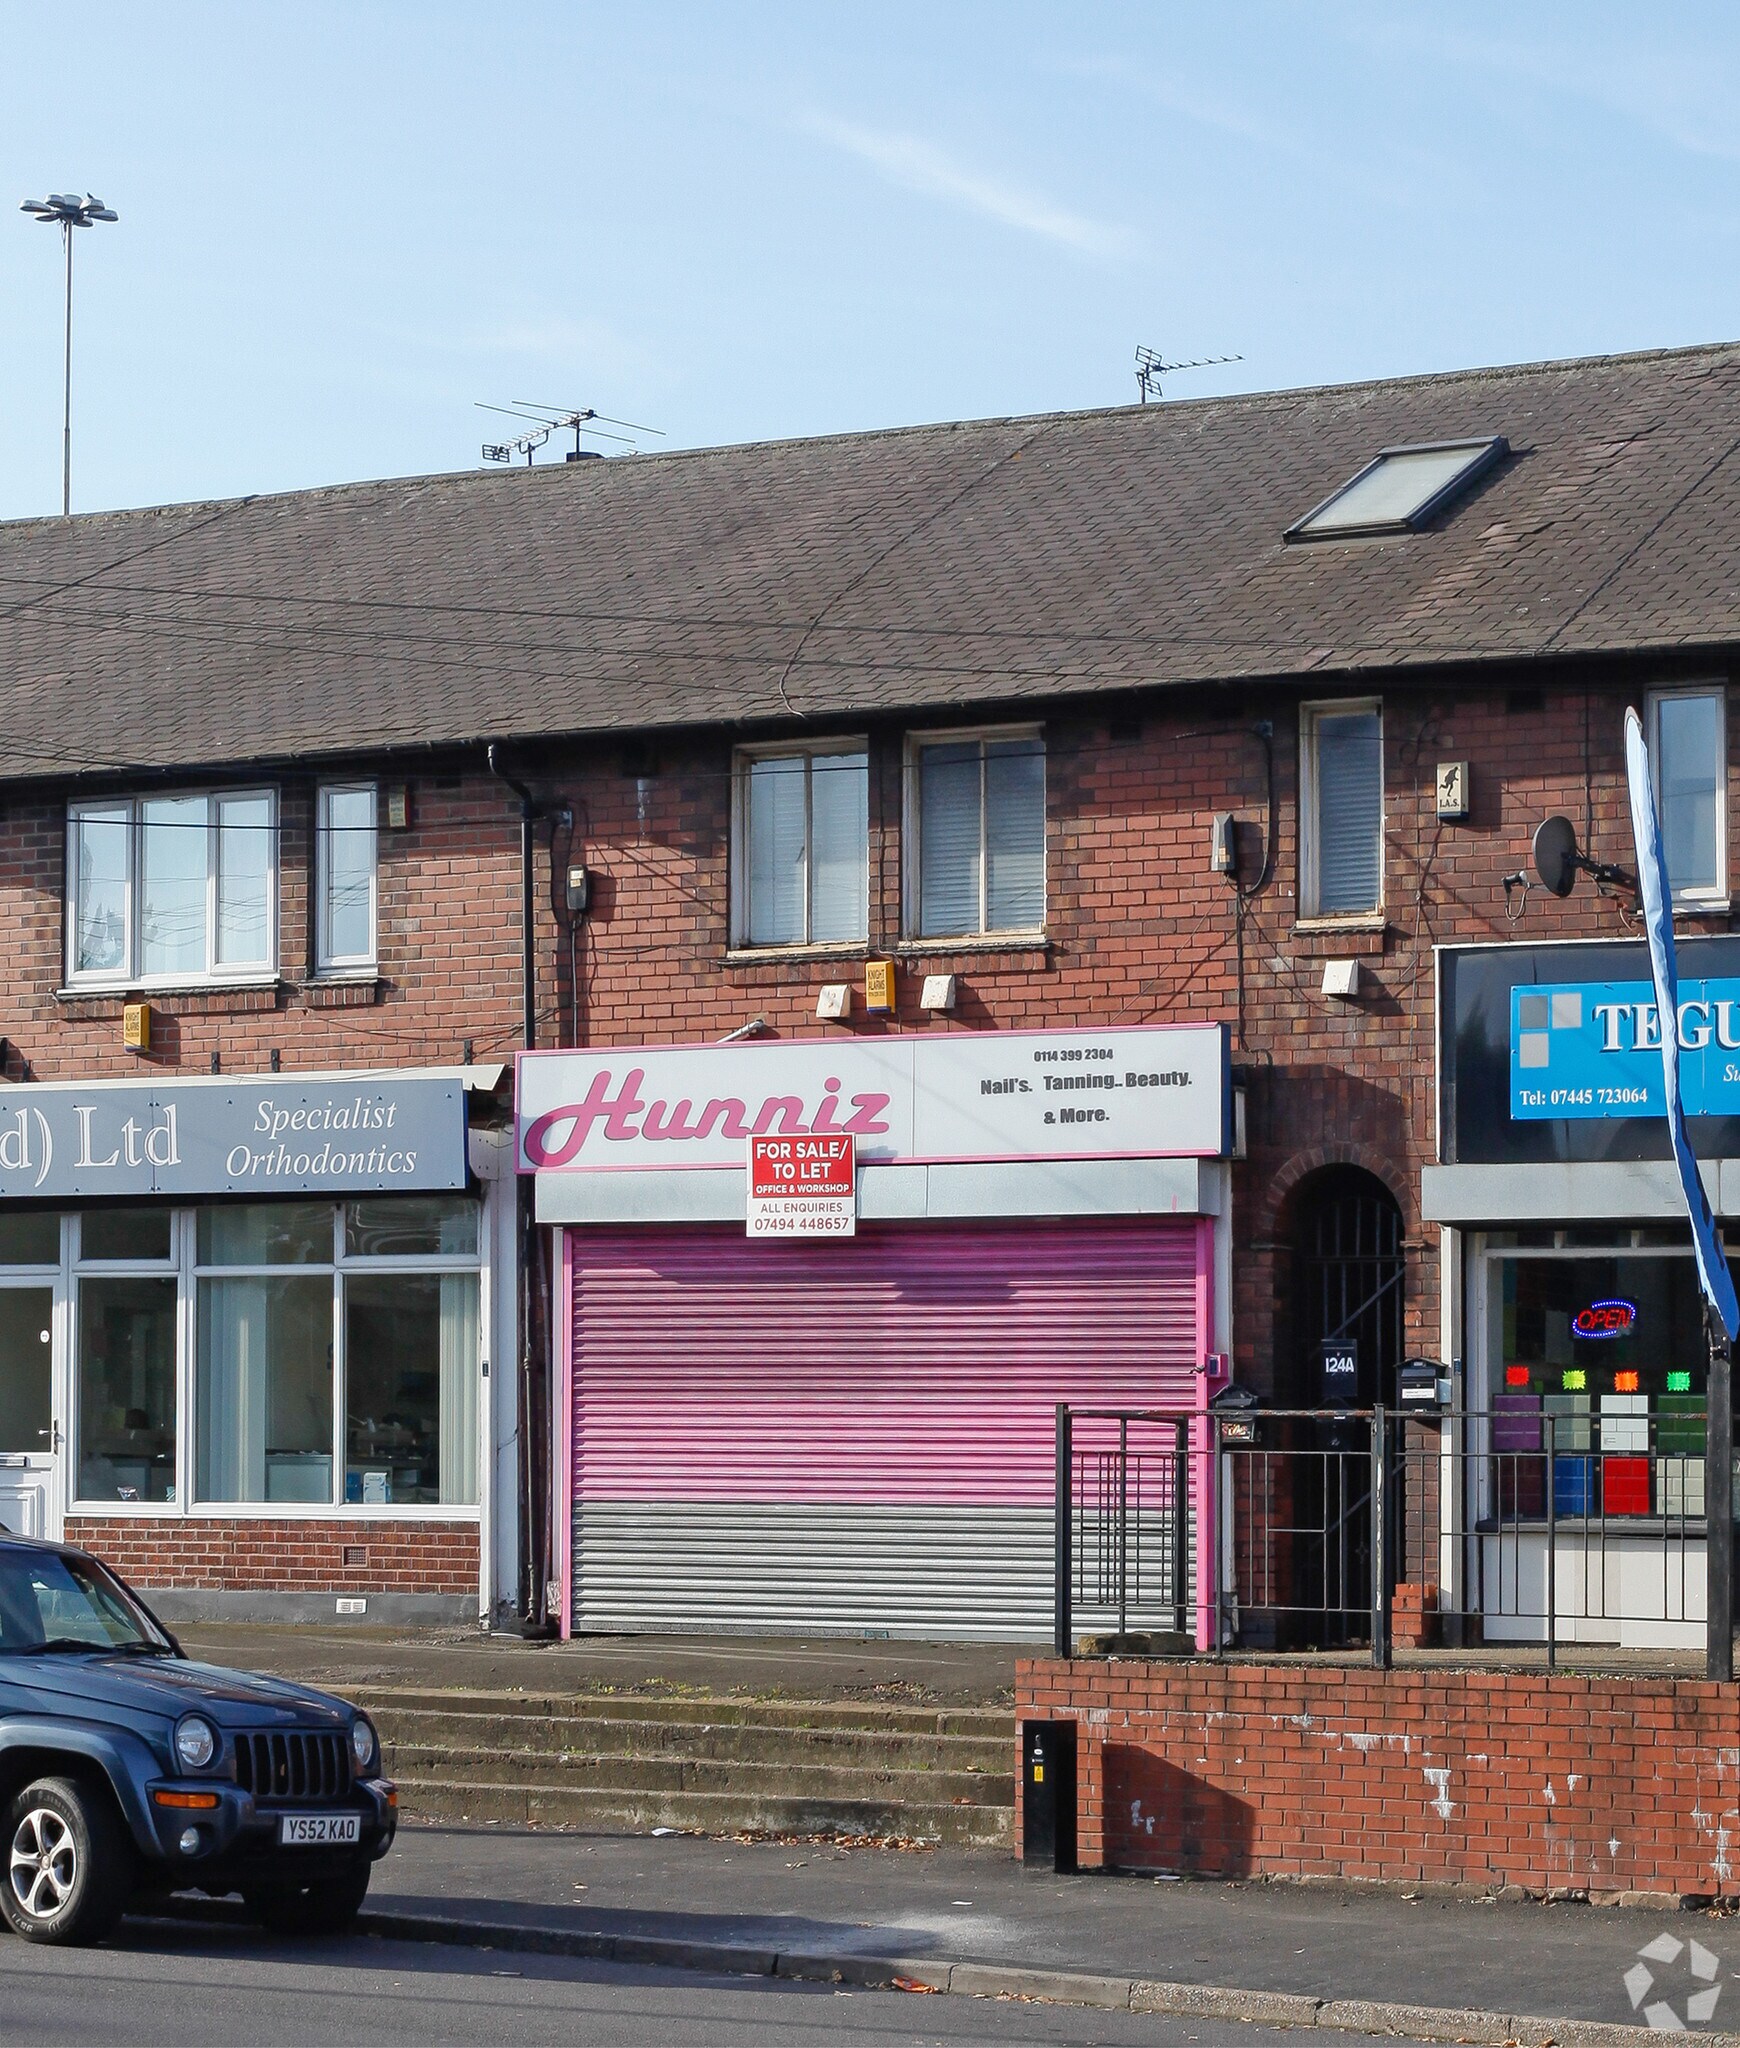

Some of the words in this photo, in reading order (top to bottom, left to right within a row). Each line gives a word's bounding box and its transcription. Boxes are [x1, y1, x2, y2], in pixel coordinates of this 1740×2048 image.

[1034, 1051, 1058, 1062] 0114
[1060, 1050, 1083, 1061] 399
[1084, 1048, 1114, 1060] 2304
[1125, 1071, 1193, 1088] Beauty.
[1520, 1090, 1546, 1105] Tel:
[1550, 1089, 1593, 1104] 07445
[1597, 1088, 1648, 1103] 723064
[254, 1097, 397, 1140] Specialist
[524, 1068, 890, 1167] Hunniz
[1043, 1111, 1056, 1124] &
[1060, 1108, 1110, 1123] More.
[73, 1103, 182, 1167] Ltd
[756, 1142, 791, 1159] FOR
[796, 1139, 849, 1160] SALE/
[226, 1143, 417, 1176] Orthodontics
[772, 1163, 796, 1179] TO
[800, 1162, 832, 1179] LET
[756, 1184, 787, 1194] OFFICE
[789, 1184, 795, 1193] &
[797, 1183, 849, 1193] WORKSHOP
[760, 1203, 780, 1213] ALL
[784, 1202, 843, 1213] ENQUIRIES
[755, 1218, 794, 1230] 07494
[799, 1217, 848, 1230] 448657
[1577, 1308, 1632, 1330] OPEN
[1325, 1357, 1354, 1373] 124A
[289, 1820, 326, 1840] YS52
